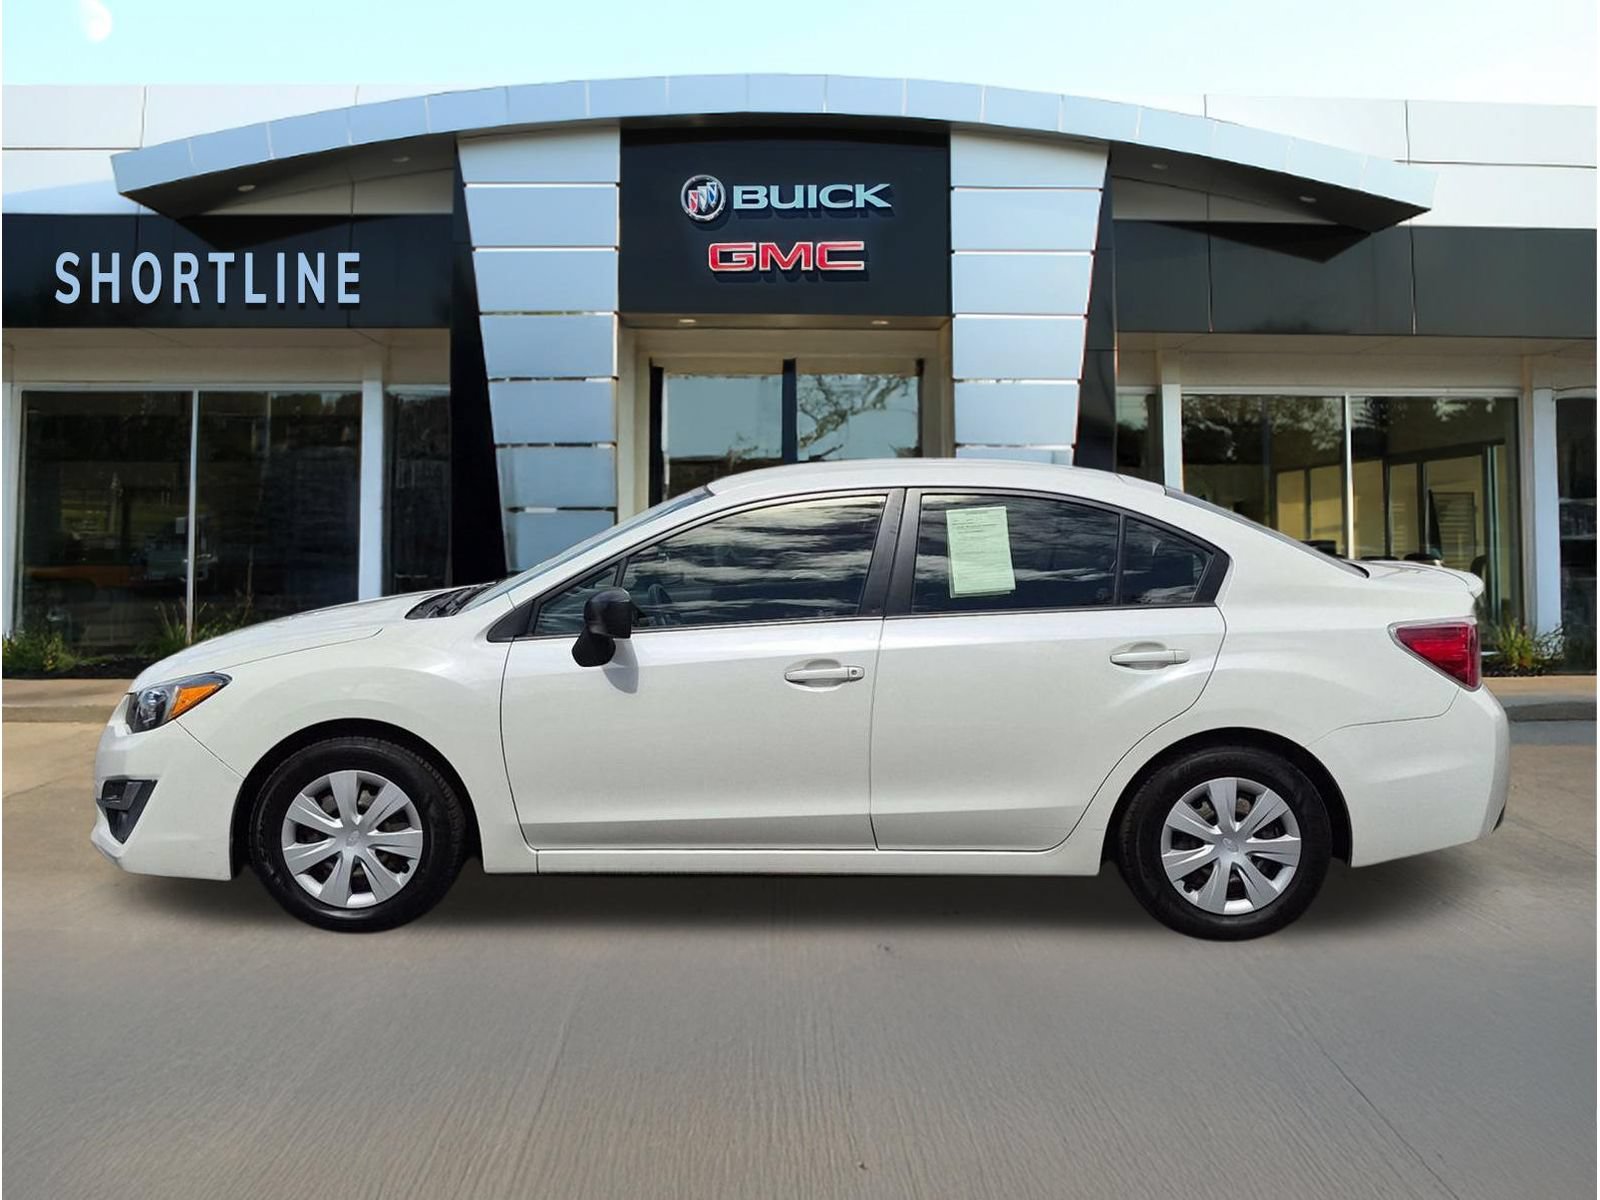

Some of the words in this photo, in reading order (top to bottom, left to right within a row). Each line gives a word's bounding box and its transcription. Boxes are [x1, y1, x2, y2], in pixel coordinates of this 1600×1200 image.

[733, 183, 892, 210] BUICK
[708, 241, 865, 271] GMC
[55, 252, 360, 304] SHORTLINE
